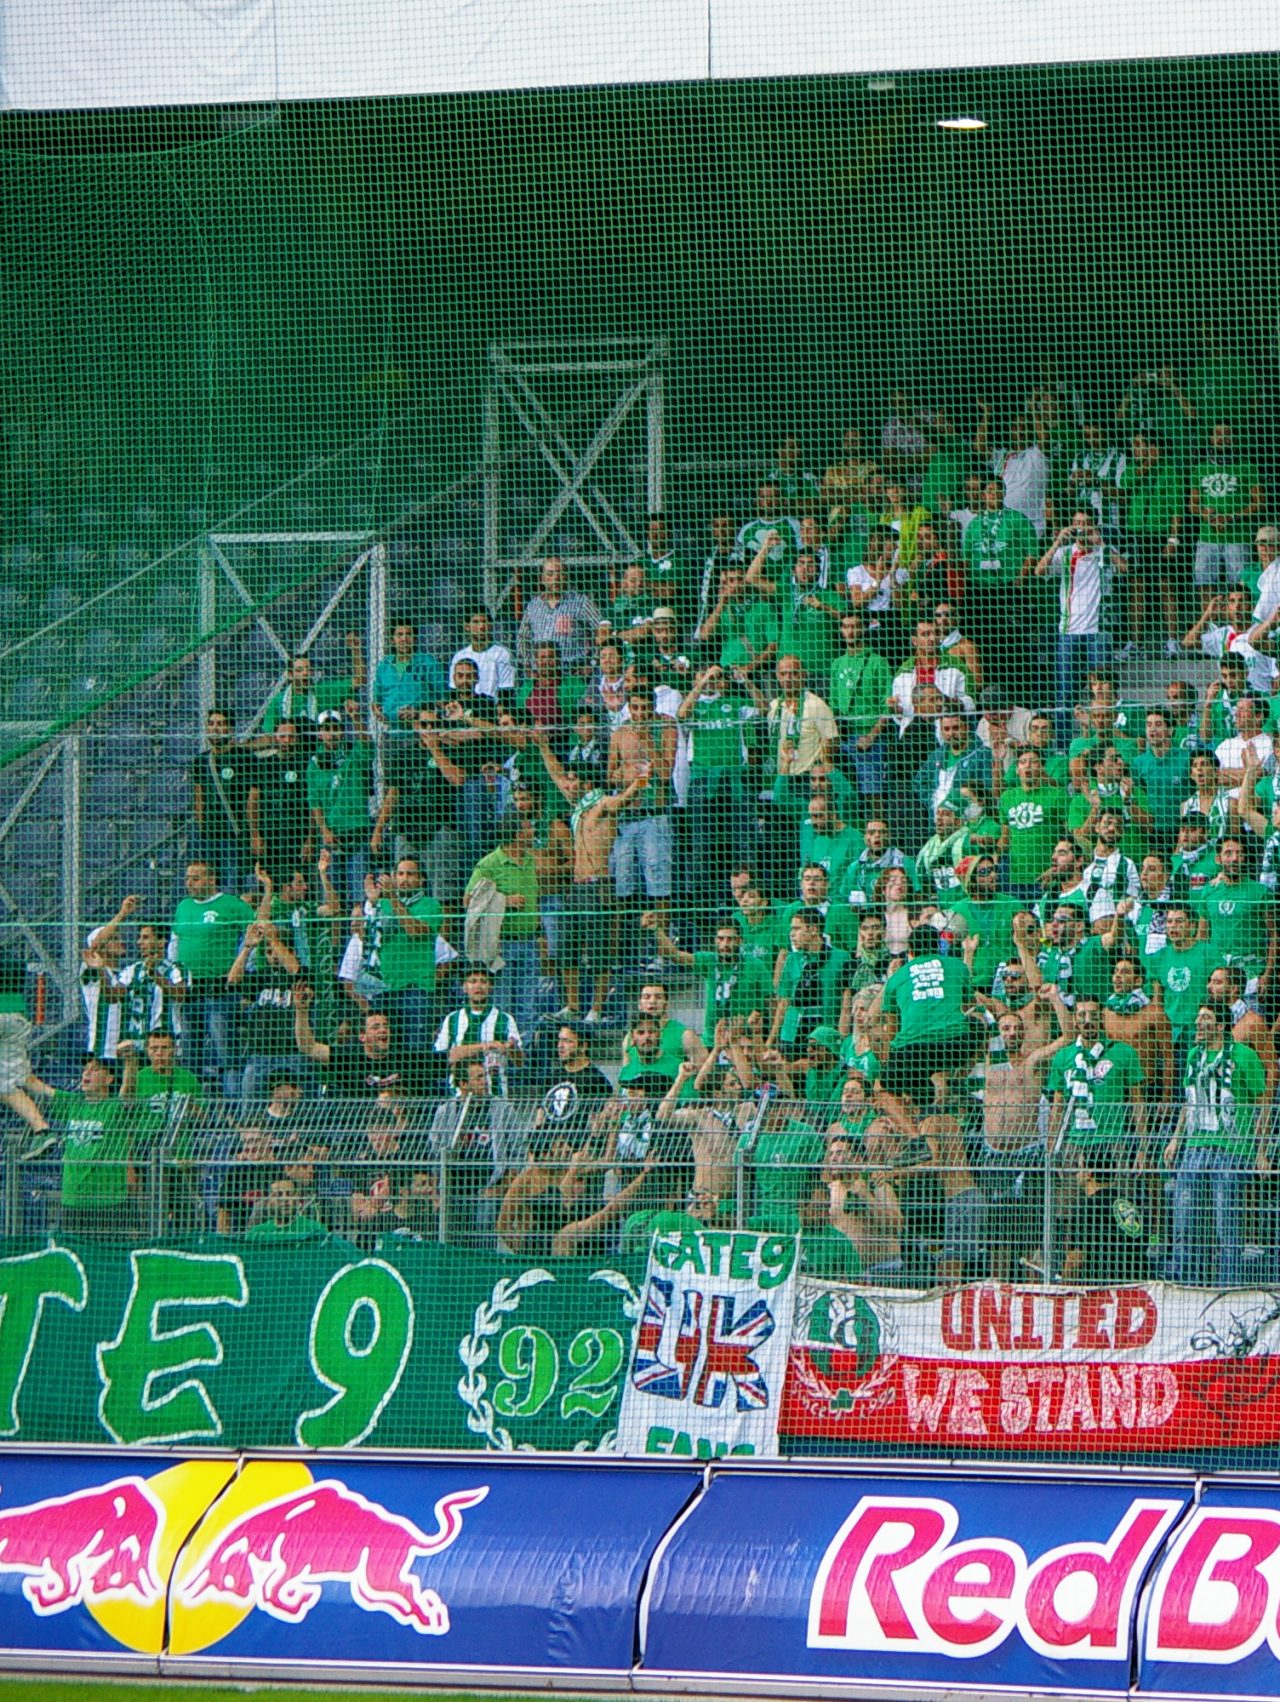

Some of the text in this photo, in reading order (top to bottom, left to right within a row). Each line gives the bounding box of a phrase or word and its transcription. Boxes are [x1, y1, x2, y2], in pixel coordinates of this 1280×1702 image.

[296, 1257, 416, 1449] 9
[941, 1286, 1158, 1351] UNITED
[494, 1325, 624, 1417] 92
[901, 1363, 1180, 1435] WE STAND
[812, 1500, 1172, 1654] Red
